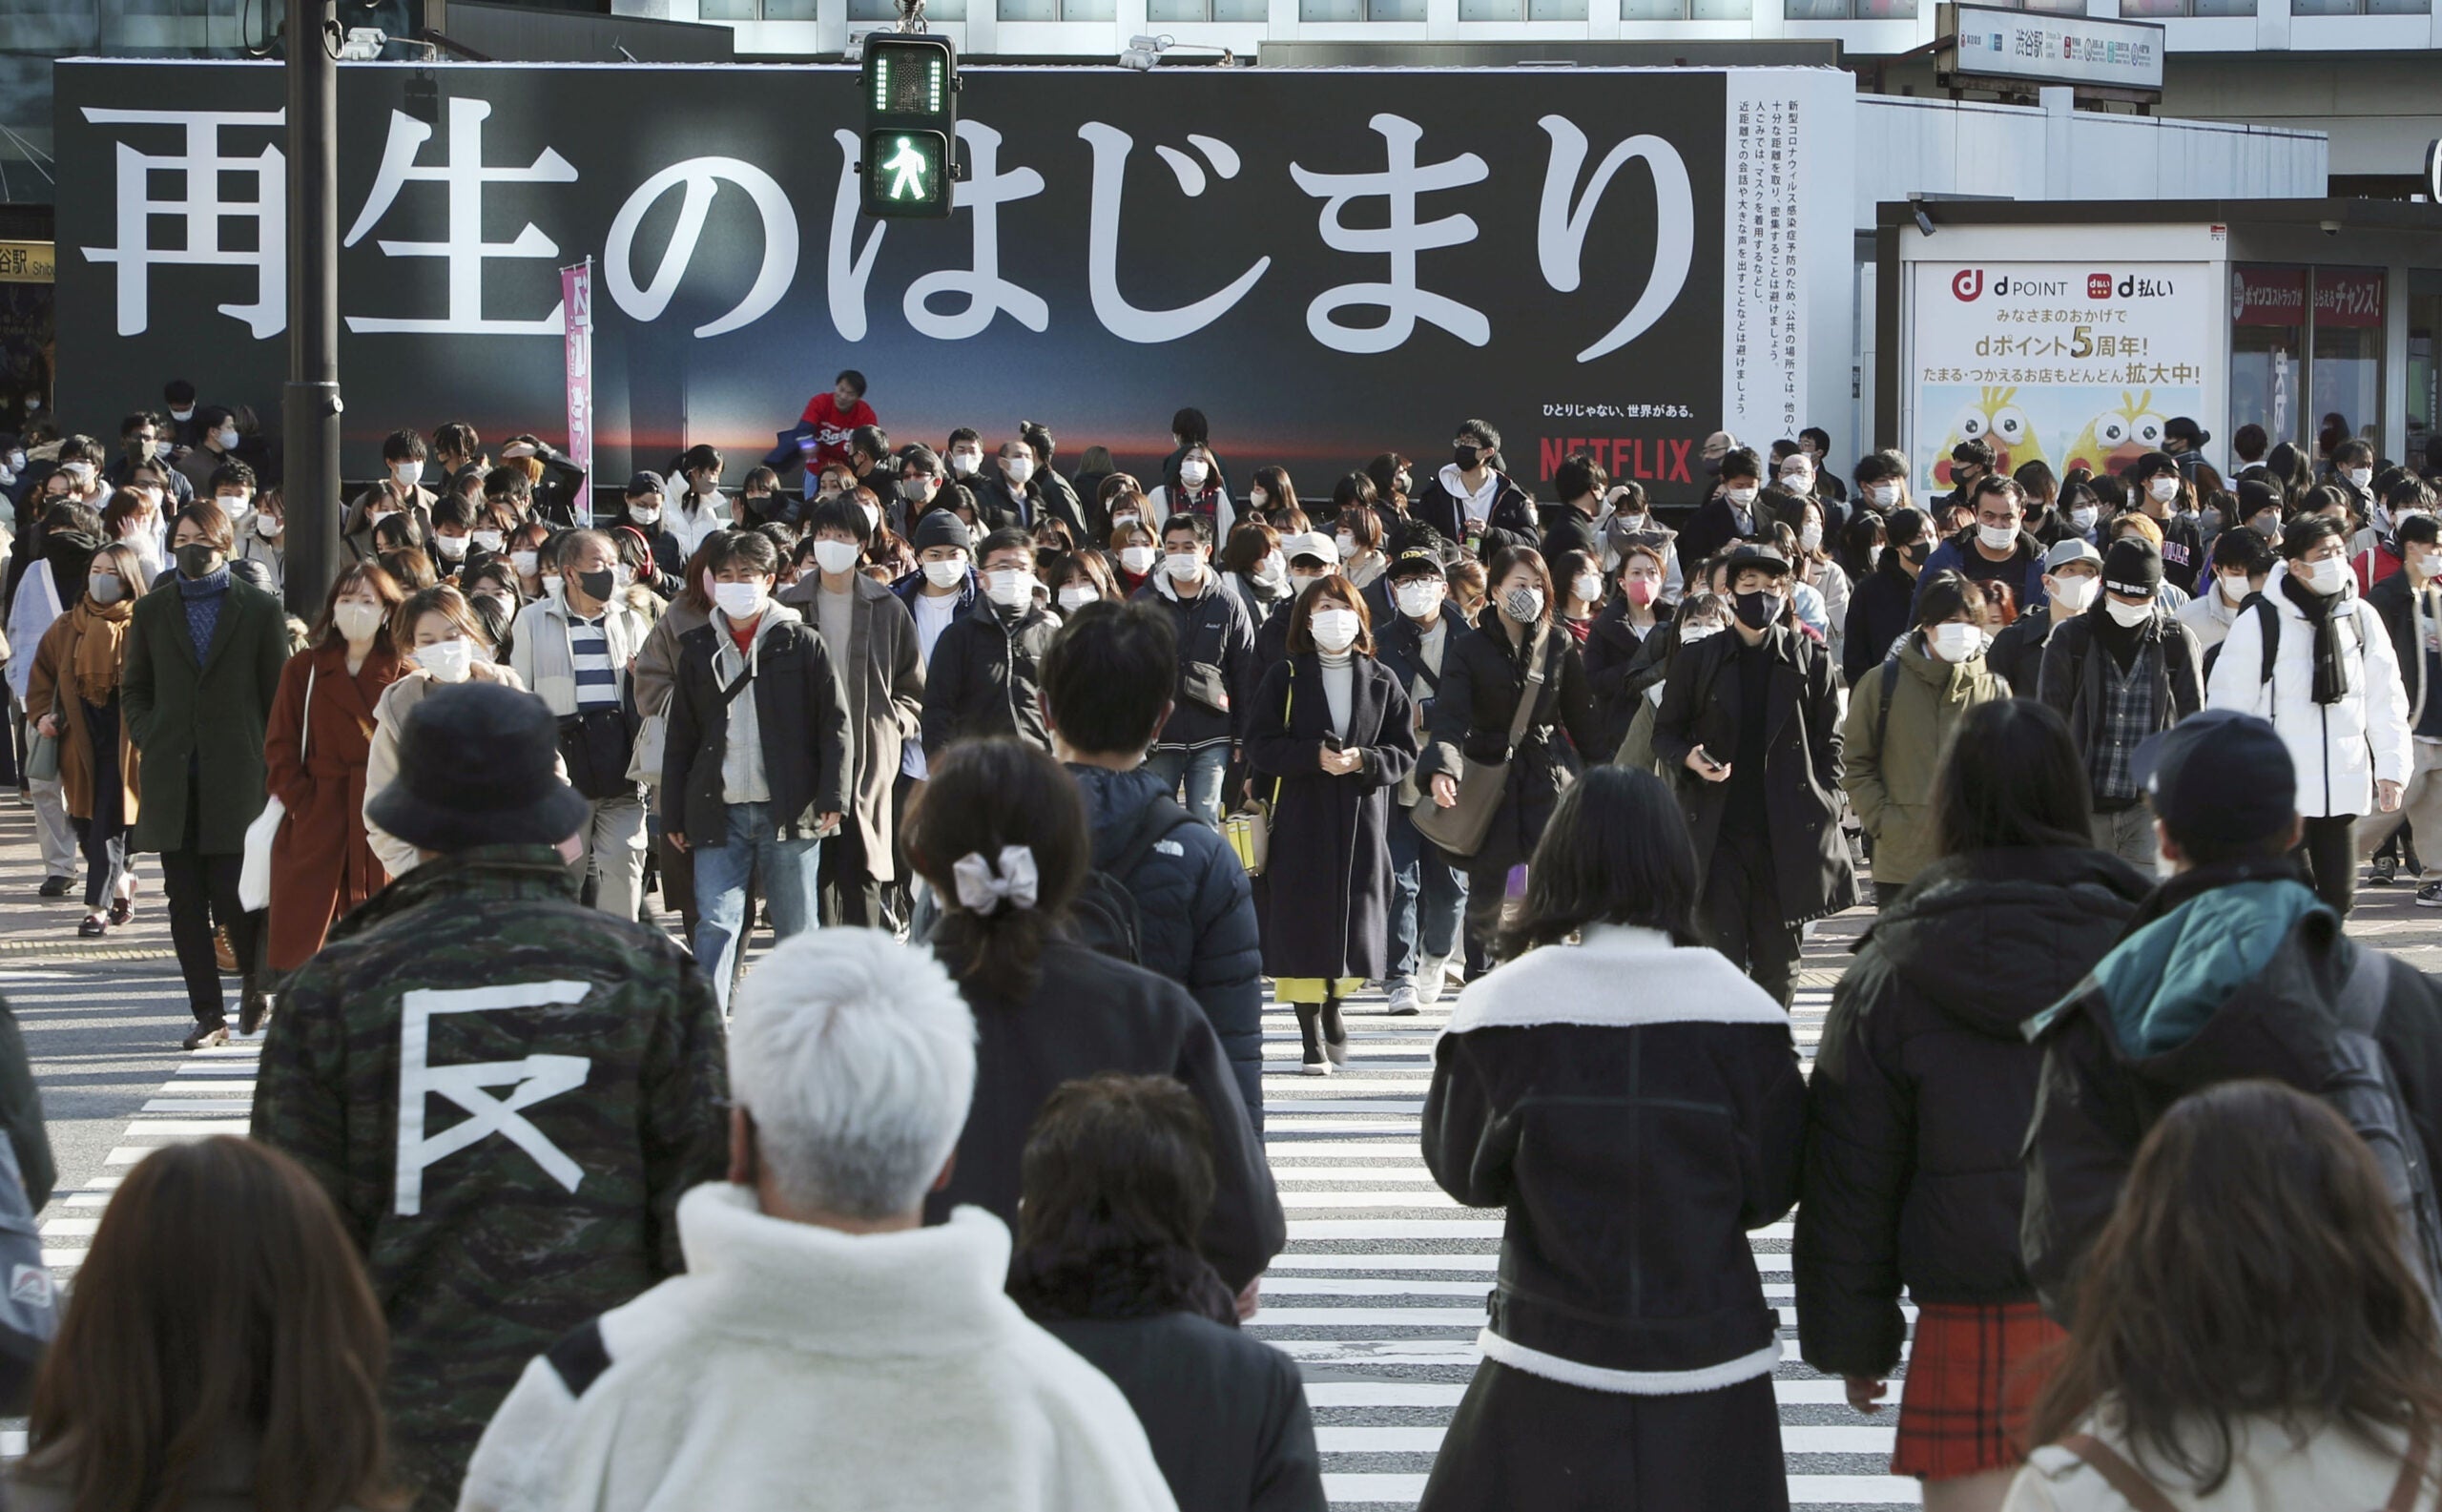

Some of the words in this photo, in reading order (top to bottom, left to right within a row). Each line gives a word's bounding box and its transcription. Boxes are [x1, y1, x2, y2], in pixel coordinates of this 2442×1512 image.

[2016, 29, 2043, 57] 渋谷駅
[79, 96, 1696, 363] 再生のはじまり
[32, 260, 54, 276] Shib
[1784, 100, 1799, 440] 新型コロナウィルス感染症予防のため、公共の場所では、他の人
[2118, 275, 2174, 298] d払い
[1997, 308, 2127, 323] みなさまのおかげで
[1542, 404, 1694, 418] ひとりじゃない、世界がある。
